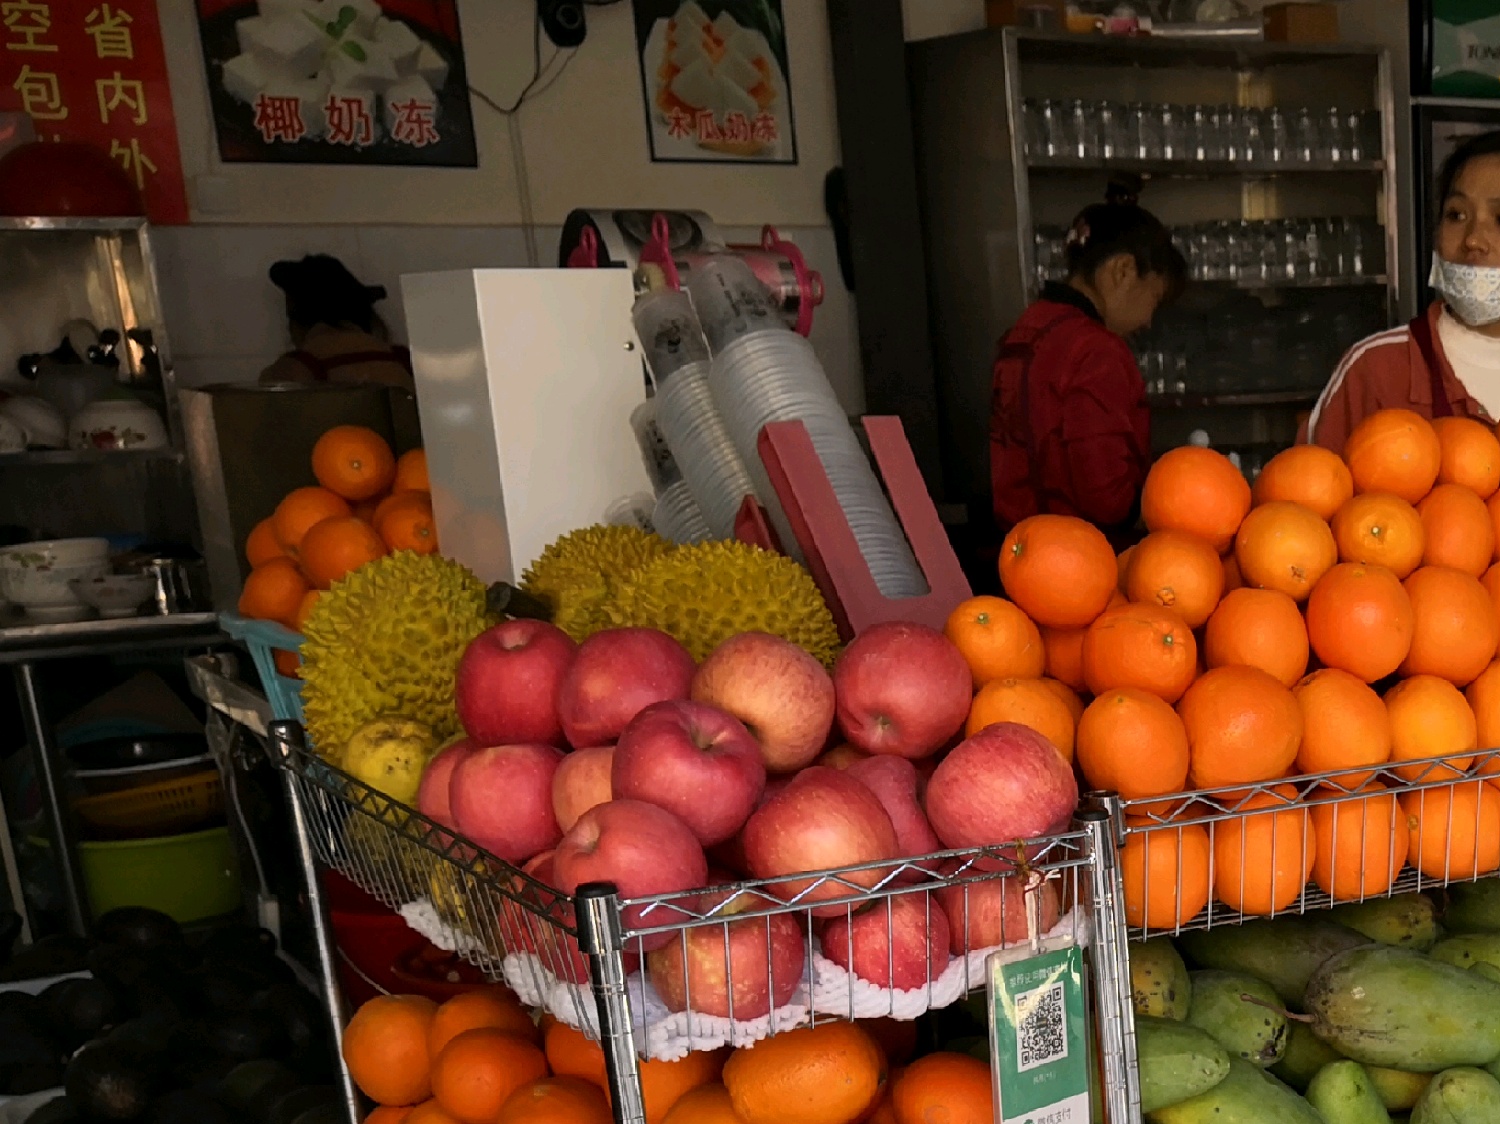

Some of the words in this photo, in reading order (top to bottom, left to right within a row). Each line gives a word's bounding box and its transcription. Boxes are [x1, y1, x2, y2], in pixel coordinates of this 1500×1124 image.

[1, 0, 68, 142] 空包
[84, 3, 157, 190] 省内外
[254, 93, 441, 148] 椰奶冻
